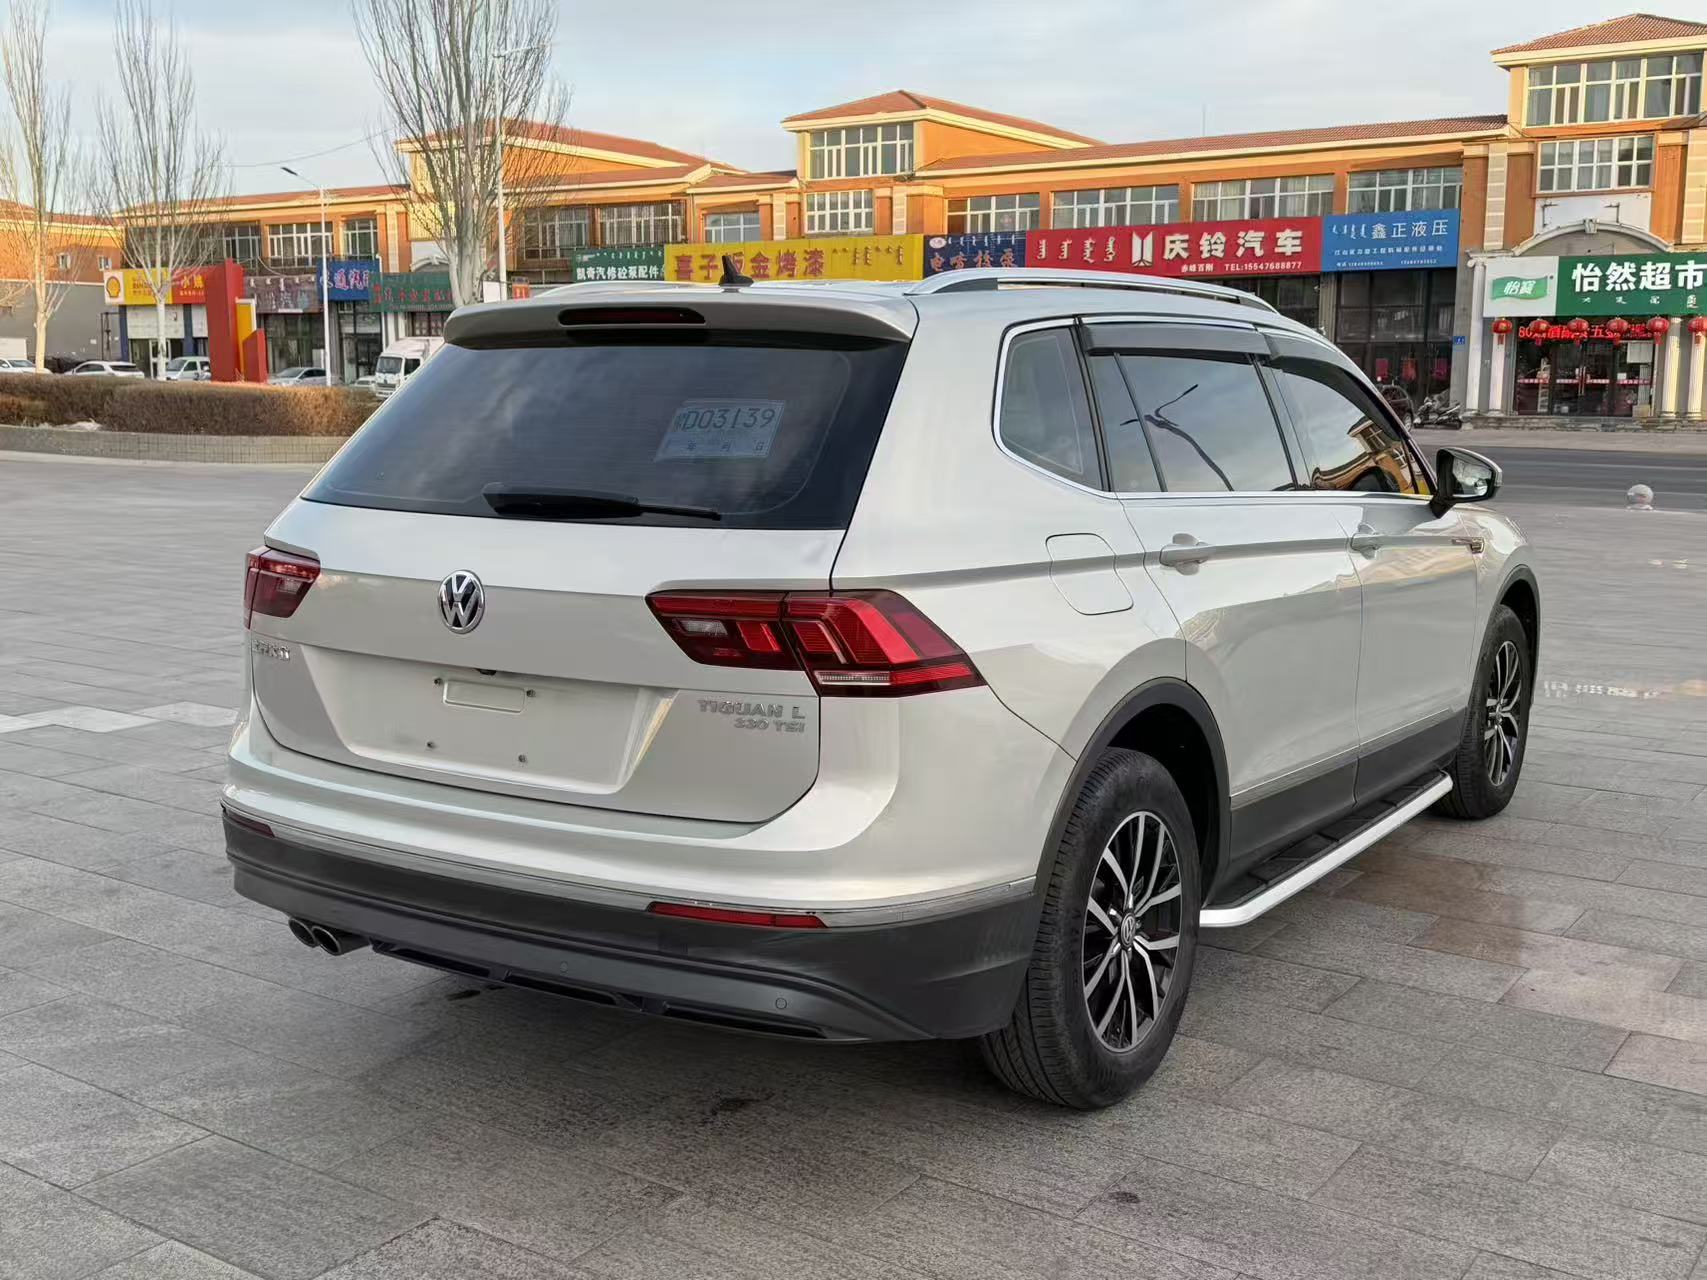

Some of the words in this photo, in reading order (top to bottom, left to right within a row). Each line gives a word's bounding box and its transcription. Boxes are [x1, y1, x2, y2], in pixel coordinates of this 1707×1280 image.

[1371, 219, 1449, 240] 鑫正液压
[1163, 228, 1303, 260] 庆铃汽车
[1572, 260, 1707, 292] 怡然超市
[698, 699, 784, 718] TIGUAN
[791, 706, 806, 719] L
[734, 718, 769, 730] 330
[774, 720, 805, 733] TSI
